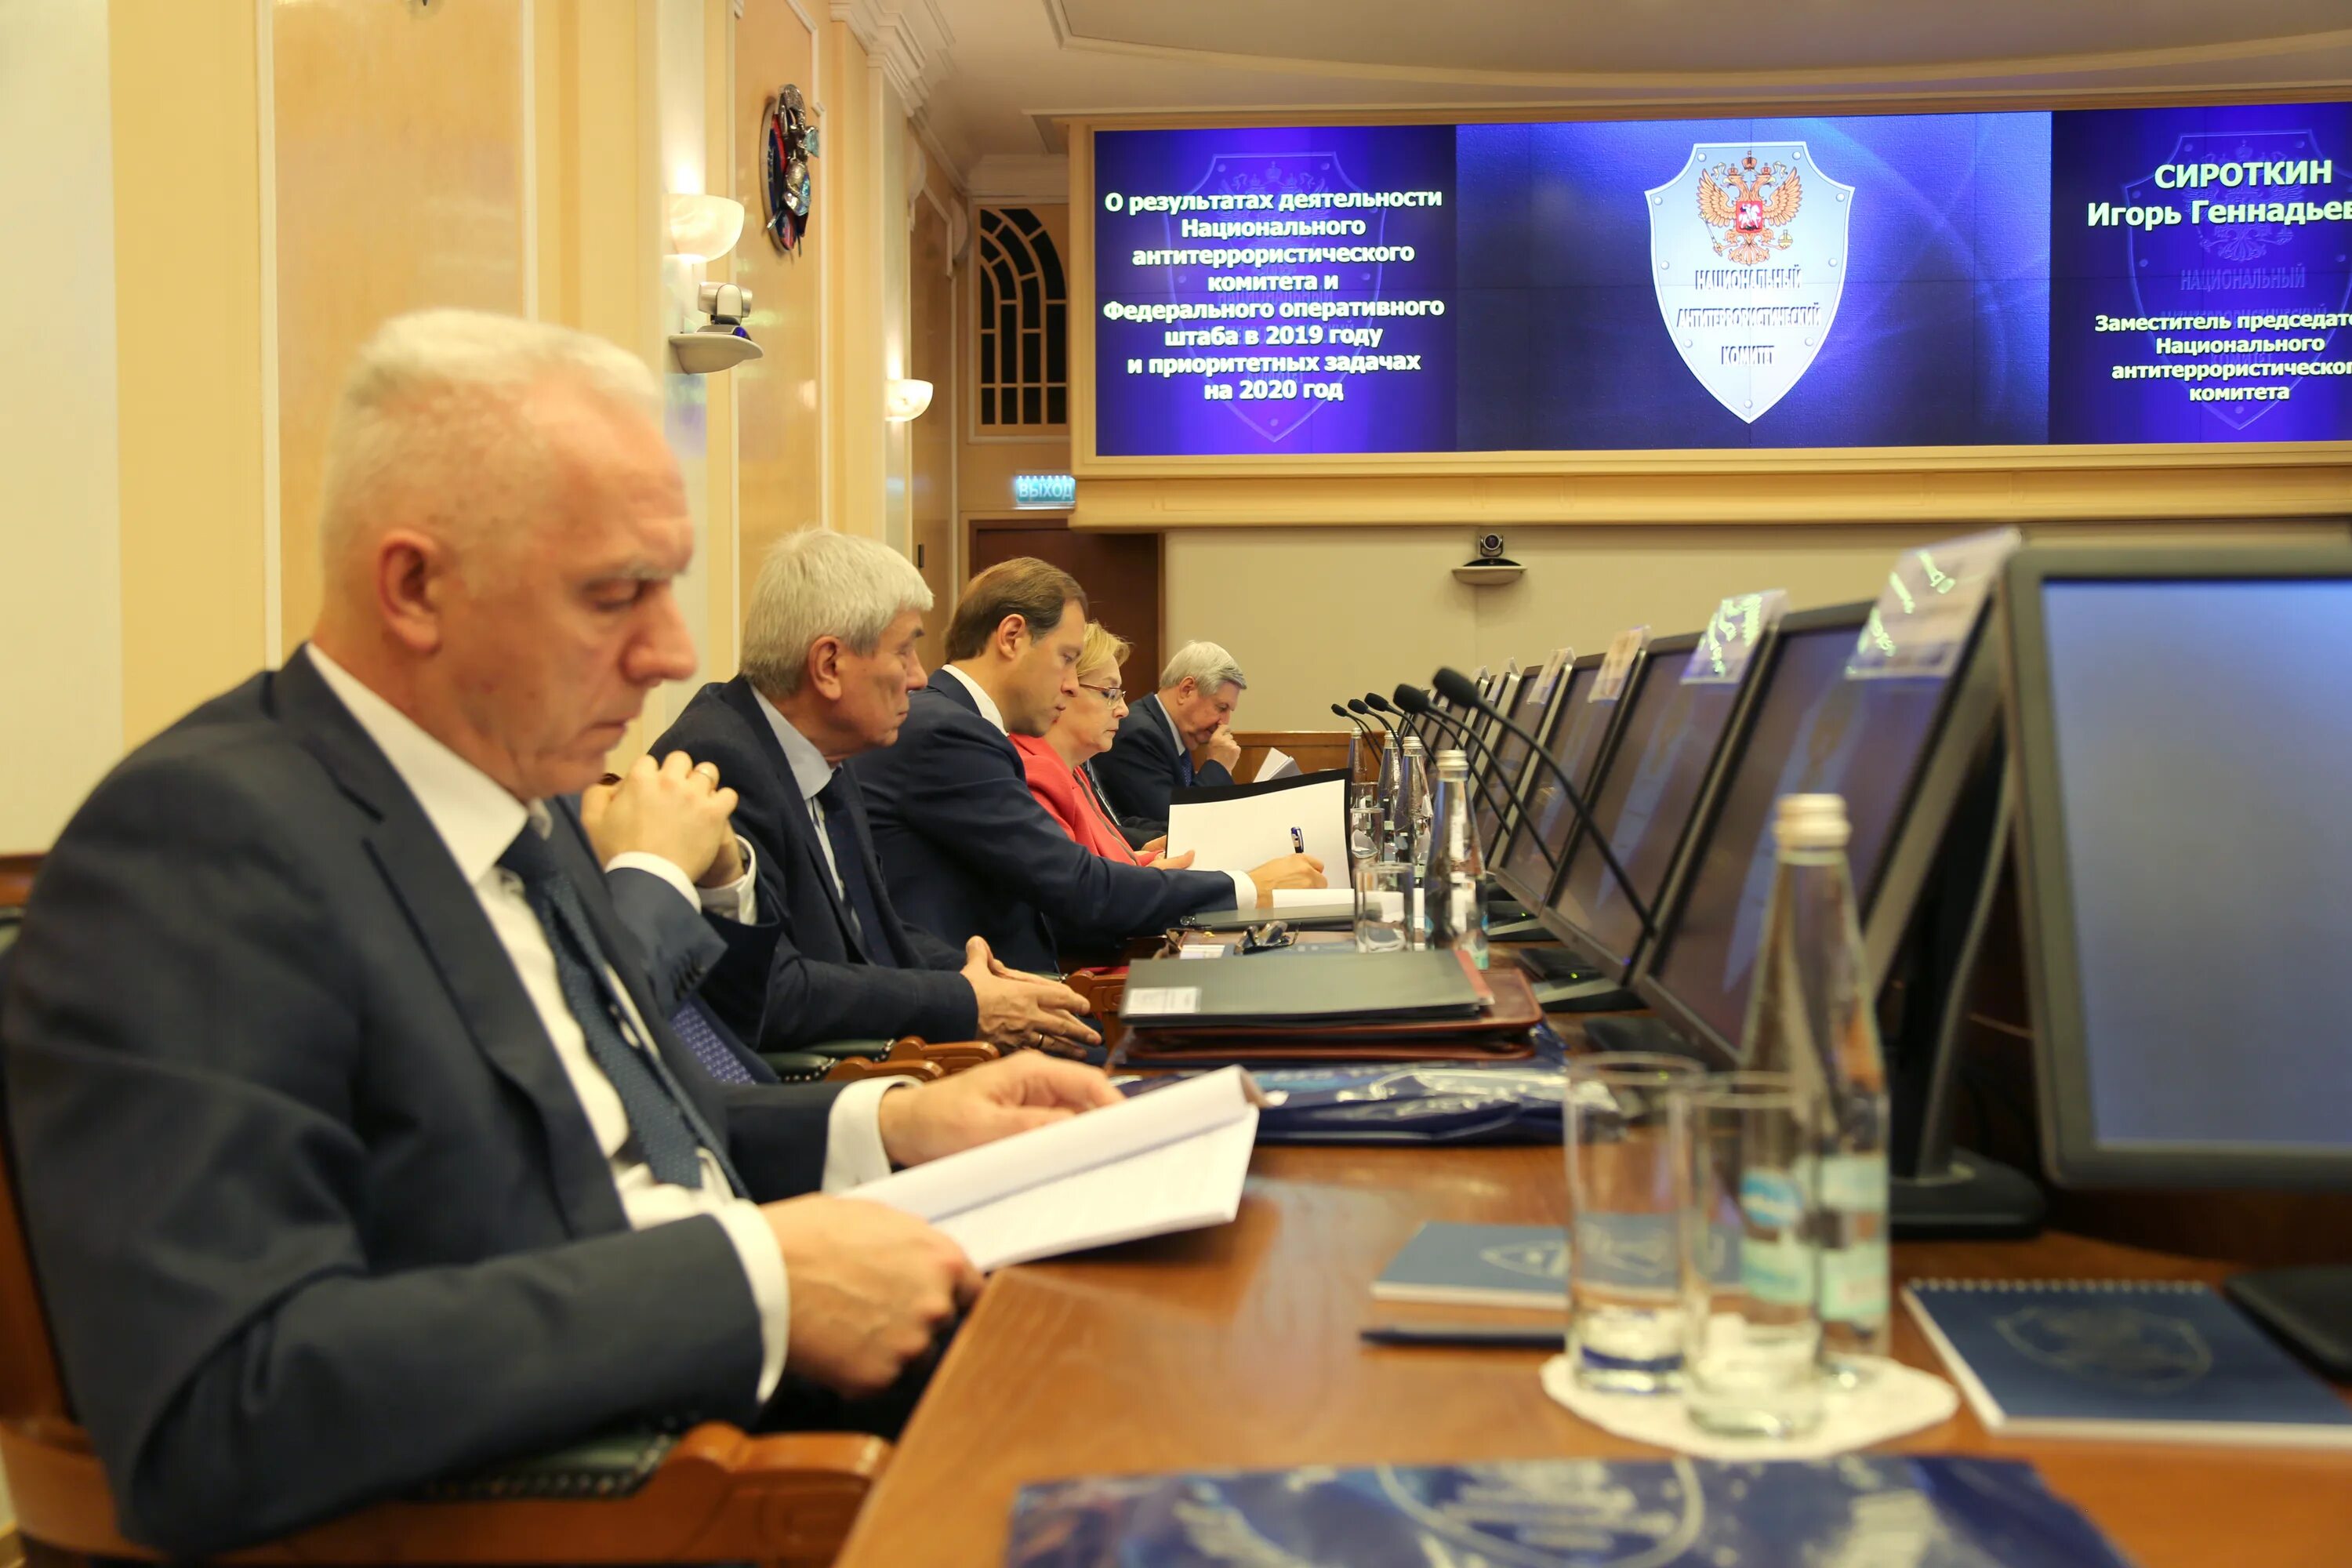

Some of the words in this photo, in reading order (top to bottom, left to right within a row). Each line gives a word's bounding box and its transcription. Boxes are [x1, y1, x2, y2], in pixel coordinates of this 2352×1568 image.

[2154, 159, 2333, 189] СИРОТКИН
[1105, 193, 1123, 212] О
[1129, 193, 1274, 216] результатах
[1278, 190, 1443, 213] деятельности
[2087, 202, 2183, 231] Игорь
[1181, 218, 1367, 241] Национального
[1131, 244, 1415, 267] антитеррористического
[1207, 274, 1318, 292] комитета
[1323, 274, 1339, 291] и
[1695, 264, 1802, 290] НАЦИОНАЛЬНЫЙ
[2180, 263, 2307, 292] НАЦИОНАЛЬНЫЙ
[1103, 300, 1275, 324] Федерального
[1278, 298, 1446, 321] оперативного
[2095, 314, 2233, 332] Заместитель
[2237, 312, 2352, 333] председат
[1164, 325, 1239, 347] штаба
[1244, 329, 1260, 345] в
[1265, 325, 1324, 346] 2019
[1329, 328, 1385, 348] году
[2156, 336, 2326, 356] Национального
[1127, 358, 1143, 374] и
[1149, 356, 1320, 378] приоритетных
[1323, 353, 1421, 374] задачах
[1203, 383, 1233, 401] на
[1239, 379, 1298, 400] 2020
[1302, 383, 1345, 401] год
[2189, 386, 2290, 401] комитета
[1018, 483, 1074, 500] ВЫХОД
